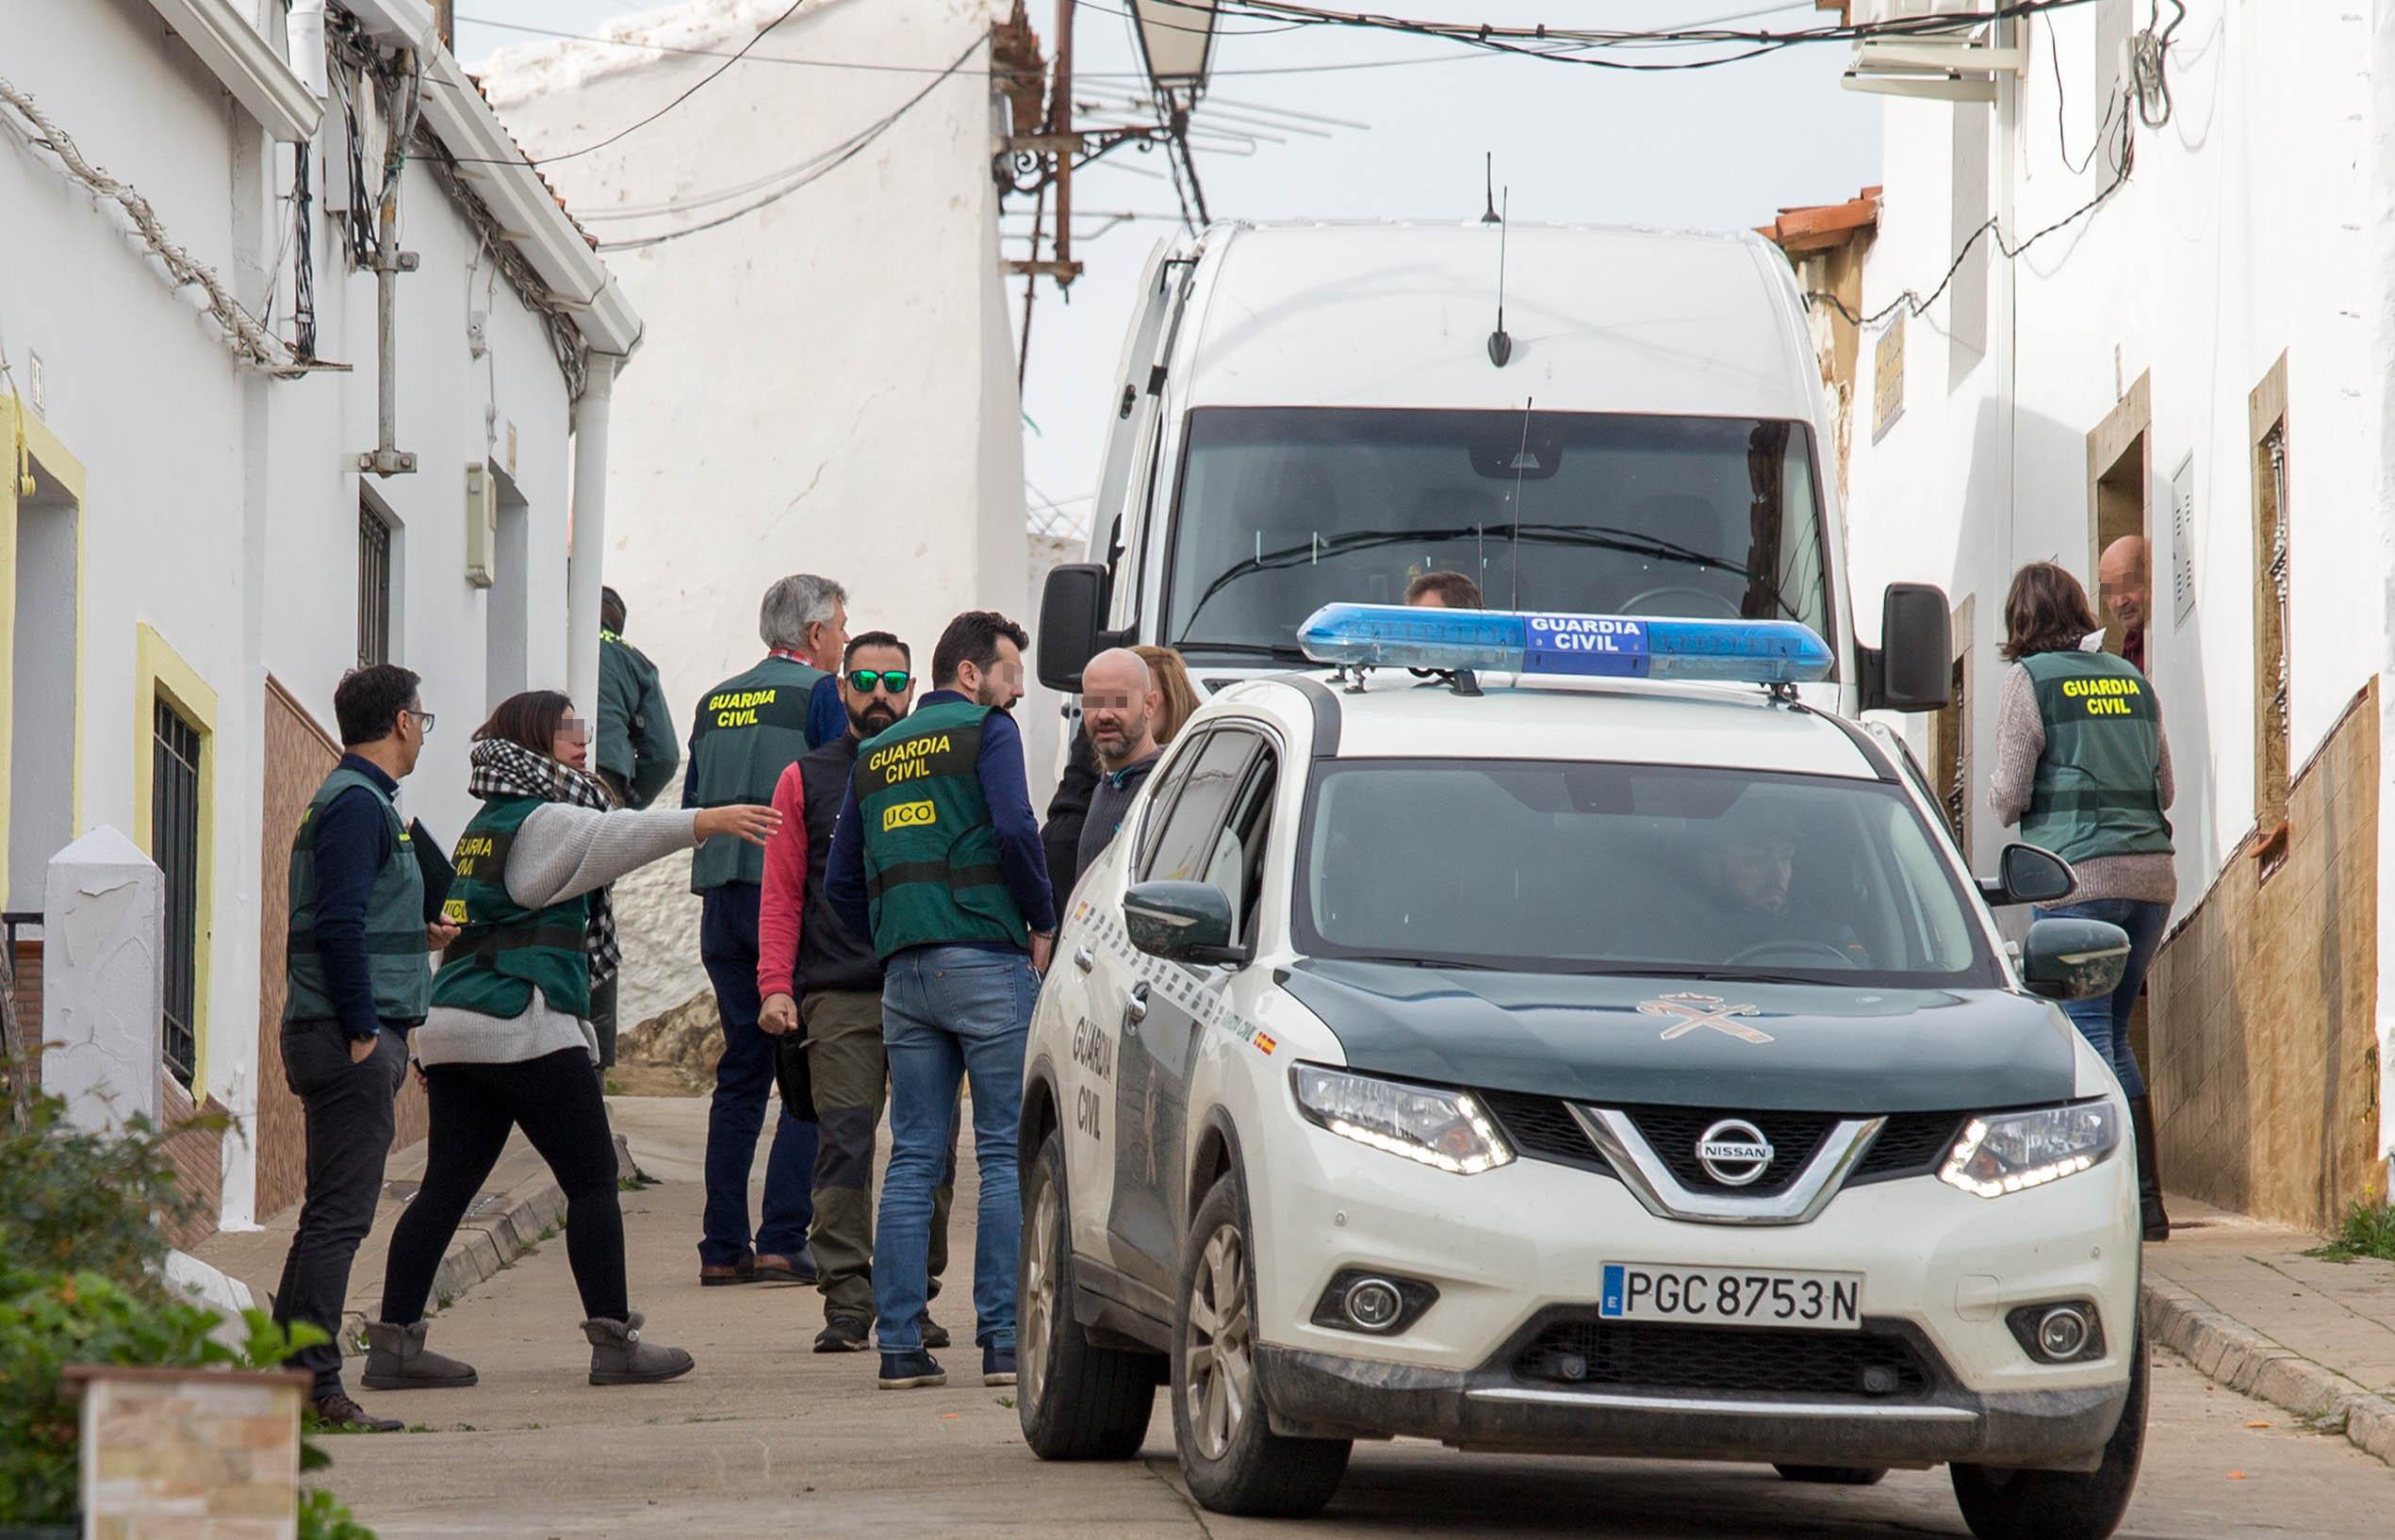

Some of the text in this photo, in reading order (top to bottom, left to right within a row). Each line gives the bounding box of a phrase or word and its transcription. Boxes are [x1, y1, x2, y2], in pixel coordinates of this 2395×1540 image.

[1531, 617, 1640, 635] GUARDIA
[1554, 632, 1619, 651] CIVIL
[2062, 679, 2141, 696] GUARDIA
[708, 688, 777, 712] GUARDIA
[2086, 697, 2131, 714] CIVIL
[717, 708, 759, 728] CIVIL
[869, 735, 951, 771] GUARDIA
[885, 757, 931, 784] CIVIL
[885, 804, 931, 827] UCO
[1073, 1015, 1112, 1086] GUARDIA
[1077, 1084, 1101, 1141] CIVIL
[1704, 1146, 1766, 1158] NISSAN
[1606, 1296, 1618, 1309] E
